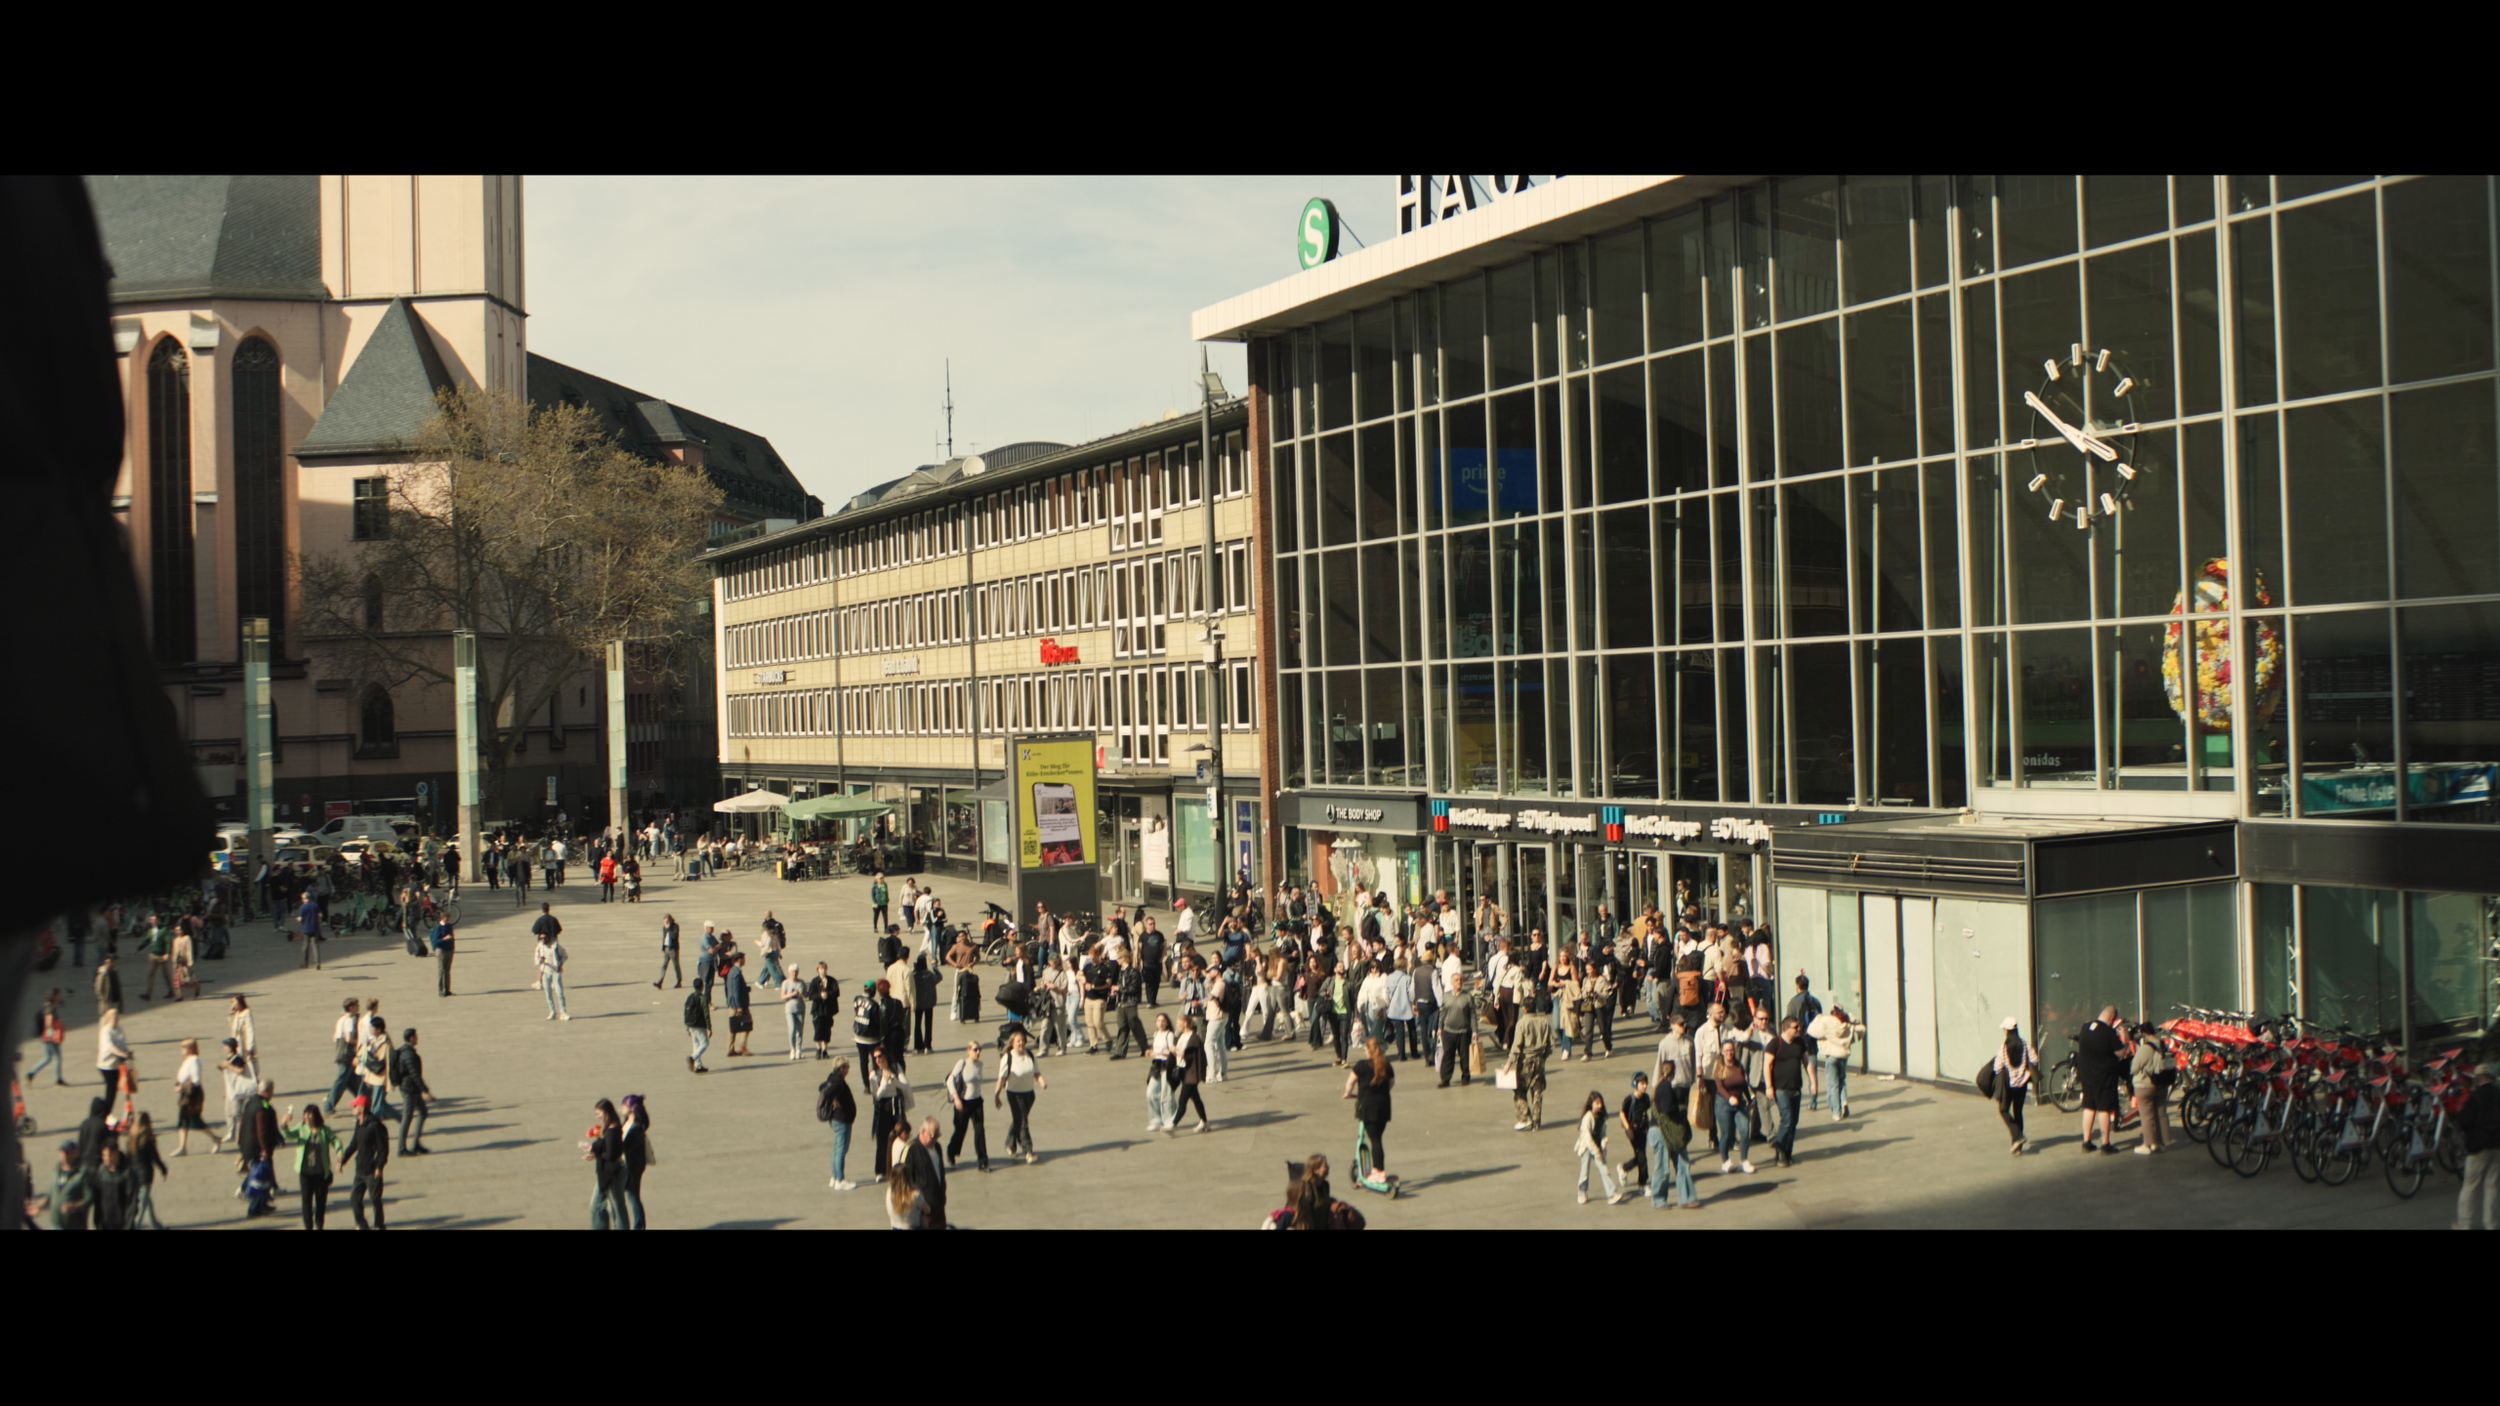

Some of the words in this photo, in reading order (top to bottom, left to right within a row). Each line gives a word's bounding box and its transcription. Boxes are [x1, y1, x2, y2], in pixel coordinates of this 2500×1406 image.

[1304, 207, 1324, 267] S
[1454, 633, 1525, 657] BOS
[1050, 763, 1061, 771] Blog
[2022, 752, 2061, 767] onidas
[2335, 780, 2367, 804] Frohe
[2368, 781, 2396, 802] Oste
[1336, 807, 1348, 819] THE
[1348, 807, 1364, 820] BODY
[1365, 808, 1381, 821] SHOP
[1448, 807, 1511, 832] NetCologne
[1533, 810, 1597, 835] Highspeed
[1624, 814, 1702, 841] NetCologne
[1732, 818, 1769, 845] Highs
